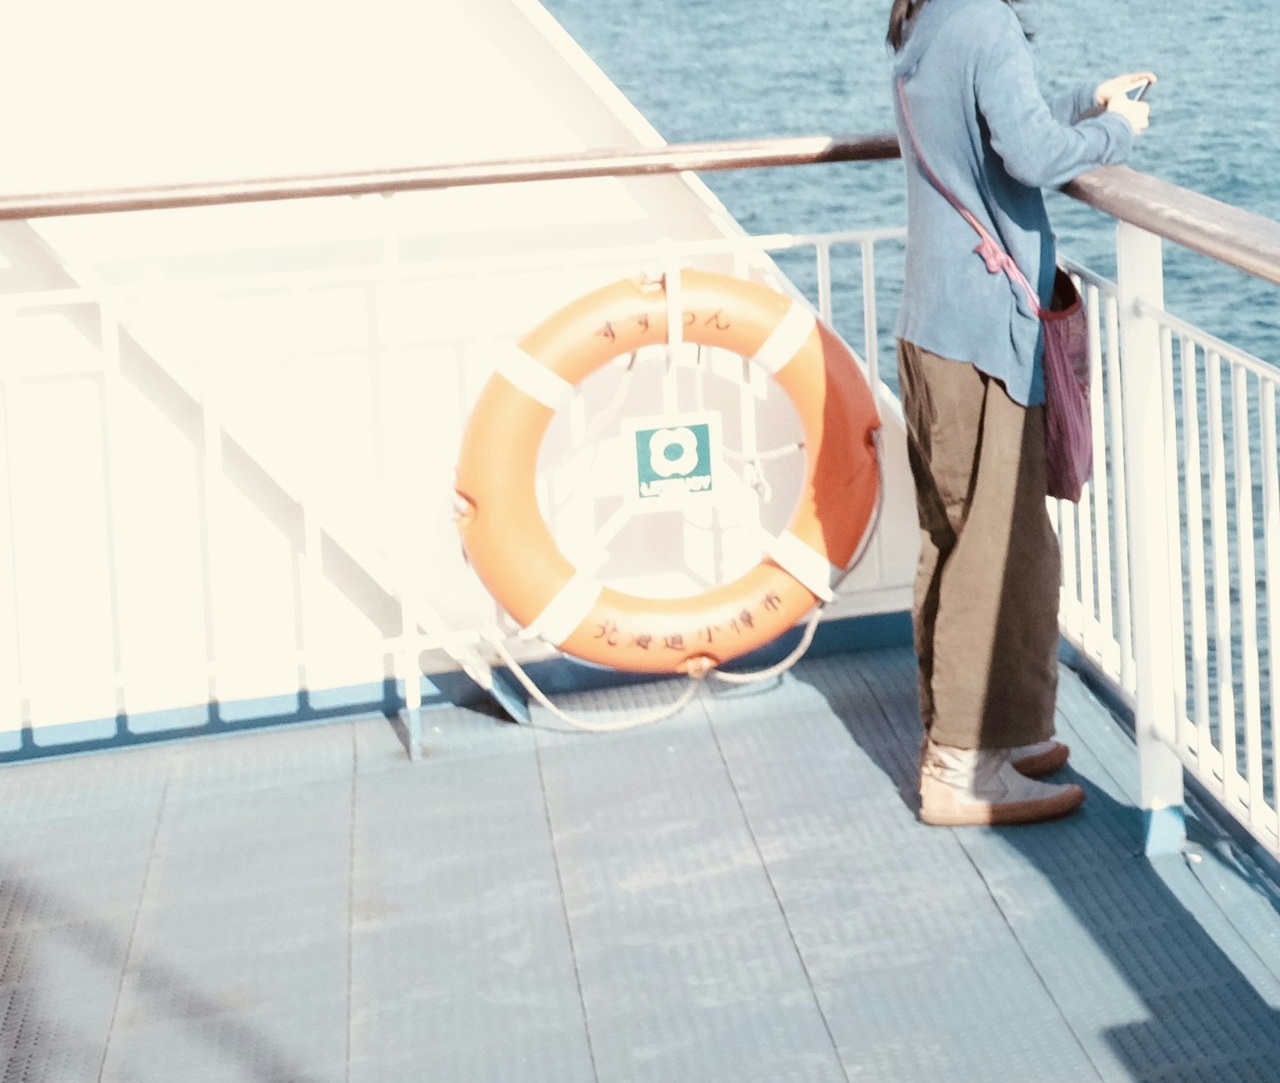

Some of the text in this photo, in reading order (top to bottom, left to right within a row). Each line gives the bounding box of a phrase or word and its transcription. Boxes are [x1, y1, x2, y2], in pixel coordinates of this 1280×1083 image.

[594, 592, 782, 651] 北海道小樽市
